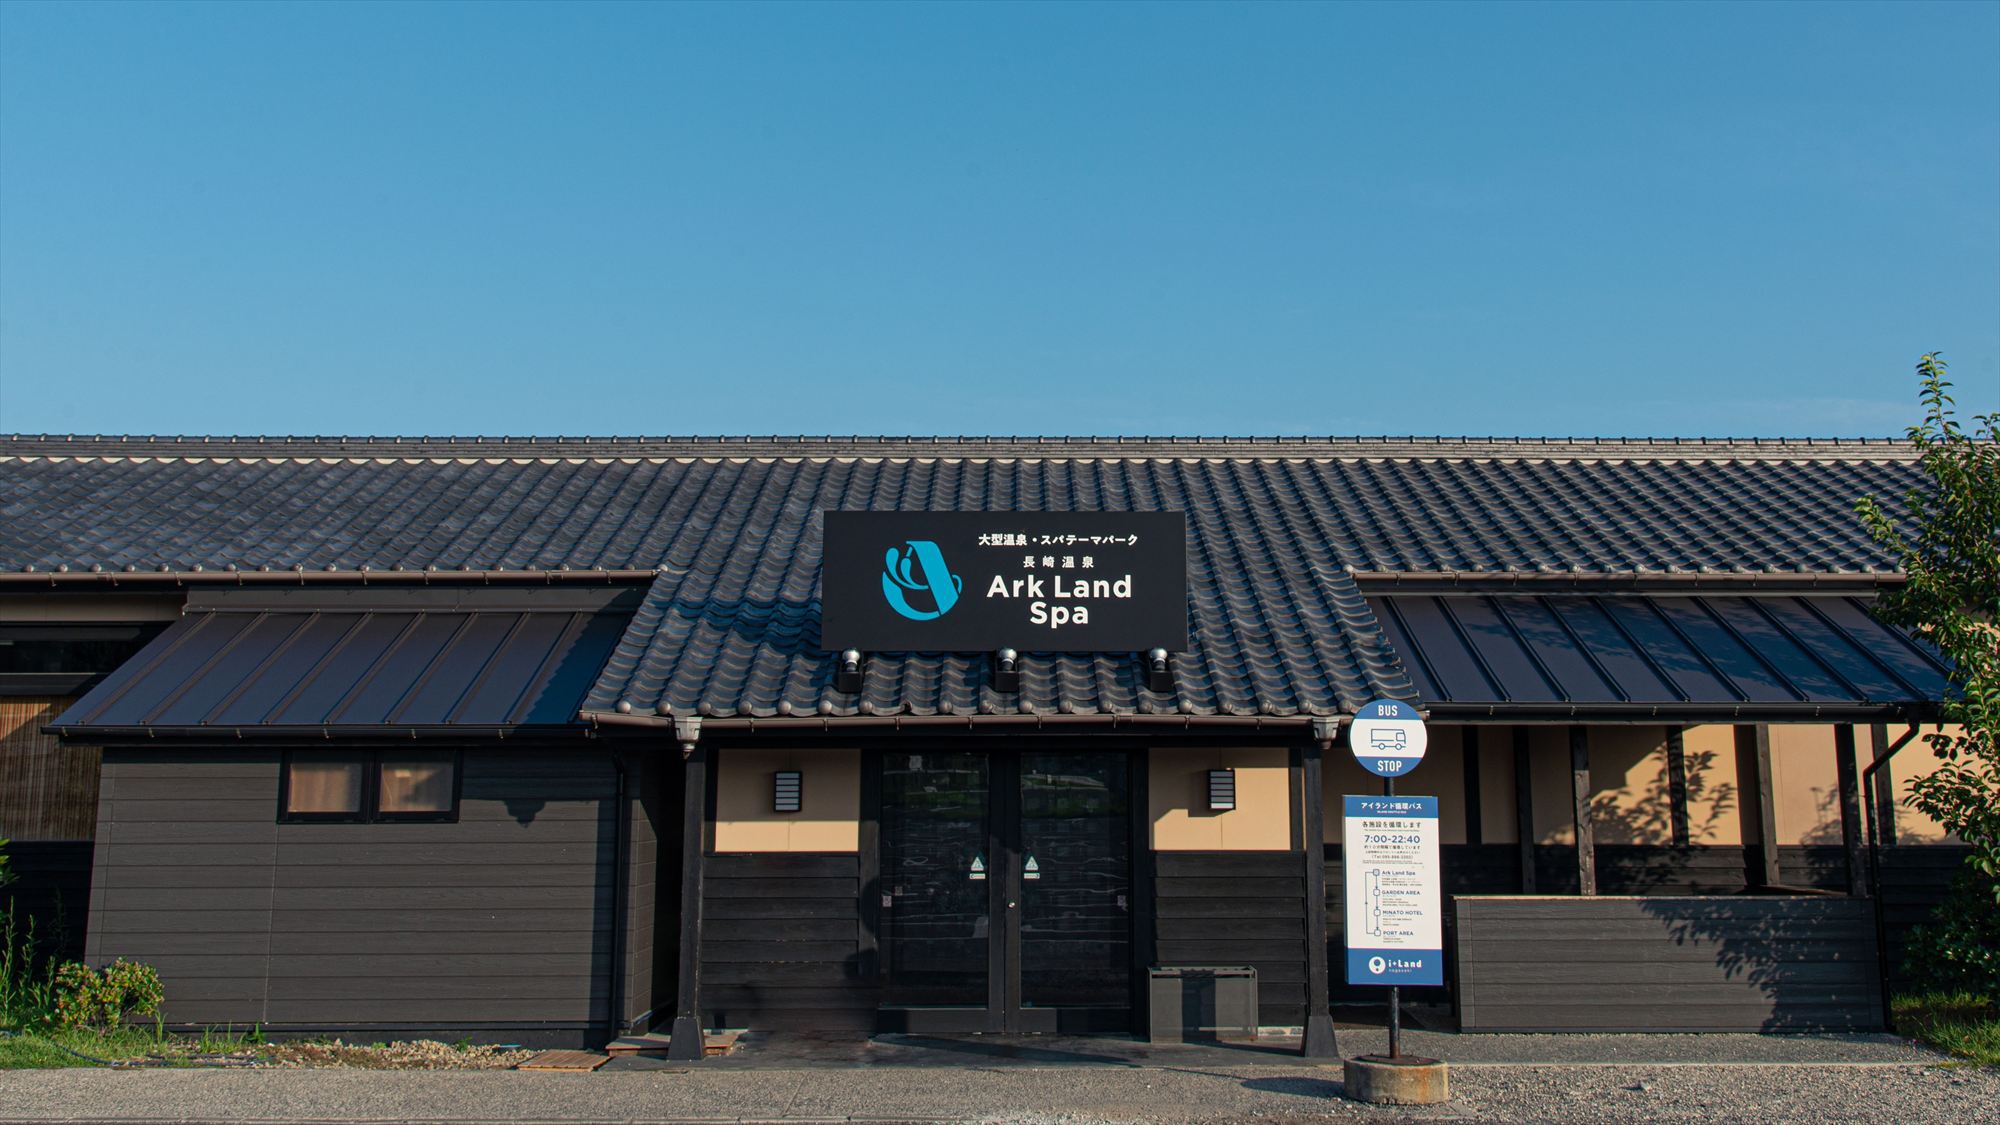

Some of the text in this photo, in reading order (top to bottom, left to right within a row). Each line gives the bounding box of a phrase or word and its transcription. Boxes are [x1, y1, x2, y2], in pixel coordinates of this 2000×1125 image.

[978, 533, 1138, 546] 大型温泉・スパテーマパーク
[986, 575, 1132, 598] Ark Land
[1030, 601, 1089, 629] Spa
[1378, 705, 1398, 716] BUS
[1377, 760, 1402, 772] STOP
[1364, 835, 1420, 843] 7:00-22:40
